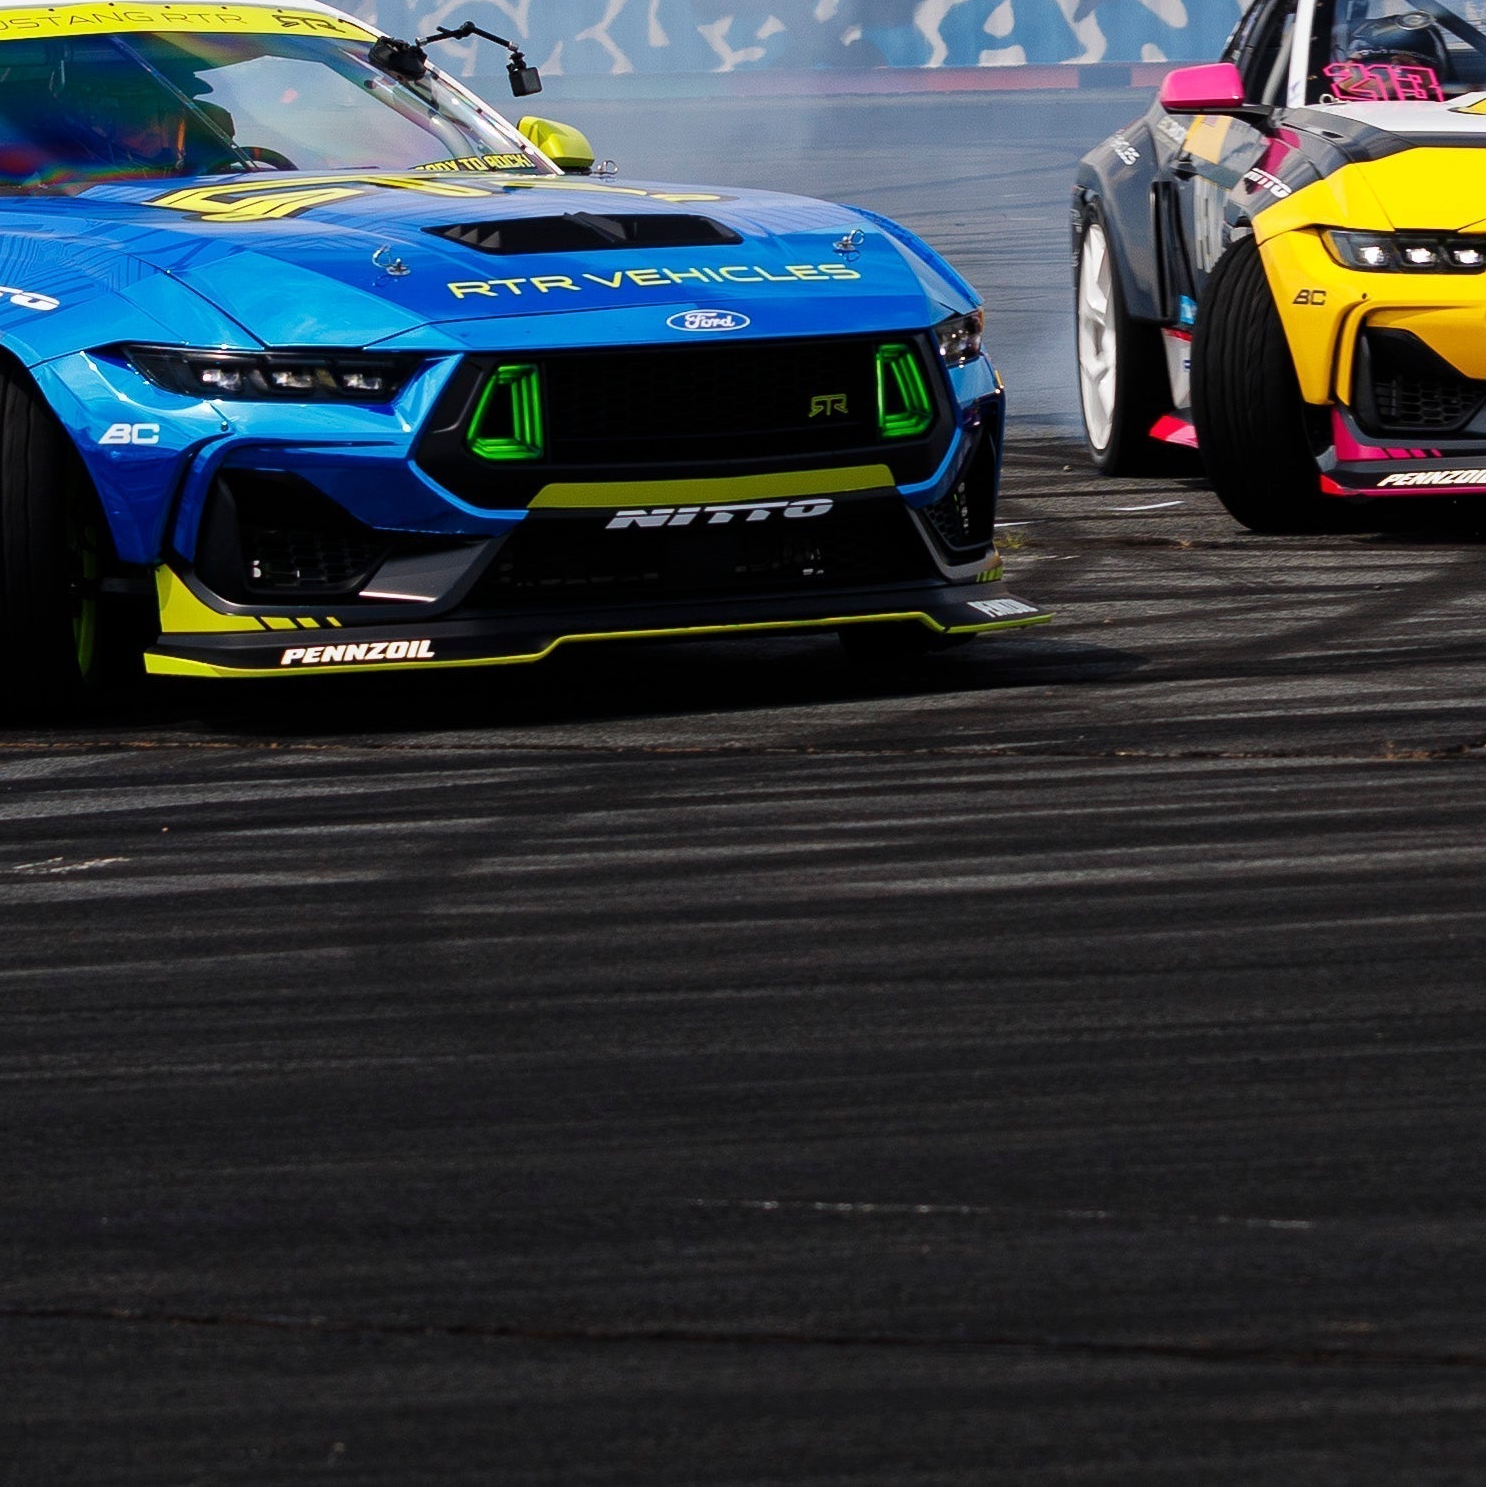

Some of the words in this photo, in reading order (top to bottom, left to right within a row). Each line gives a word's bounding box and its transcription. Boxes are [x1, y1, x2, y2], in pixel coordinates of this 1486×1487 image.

[161, 12, 245, 25] RTR
[458, 157, 490, 171] TO
[483, 153, 536, 169] ROCK!
[447, 275, 582, 299] RTR
[584, 263, 861, 289] VEHICLES
[1293, 289, 1327, 306] BC
[98, 423, 160, 445] BC
[605, 497, 834, 531] NITTO
[280, 639, 436, 666] PENNZOIL
